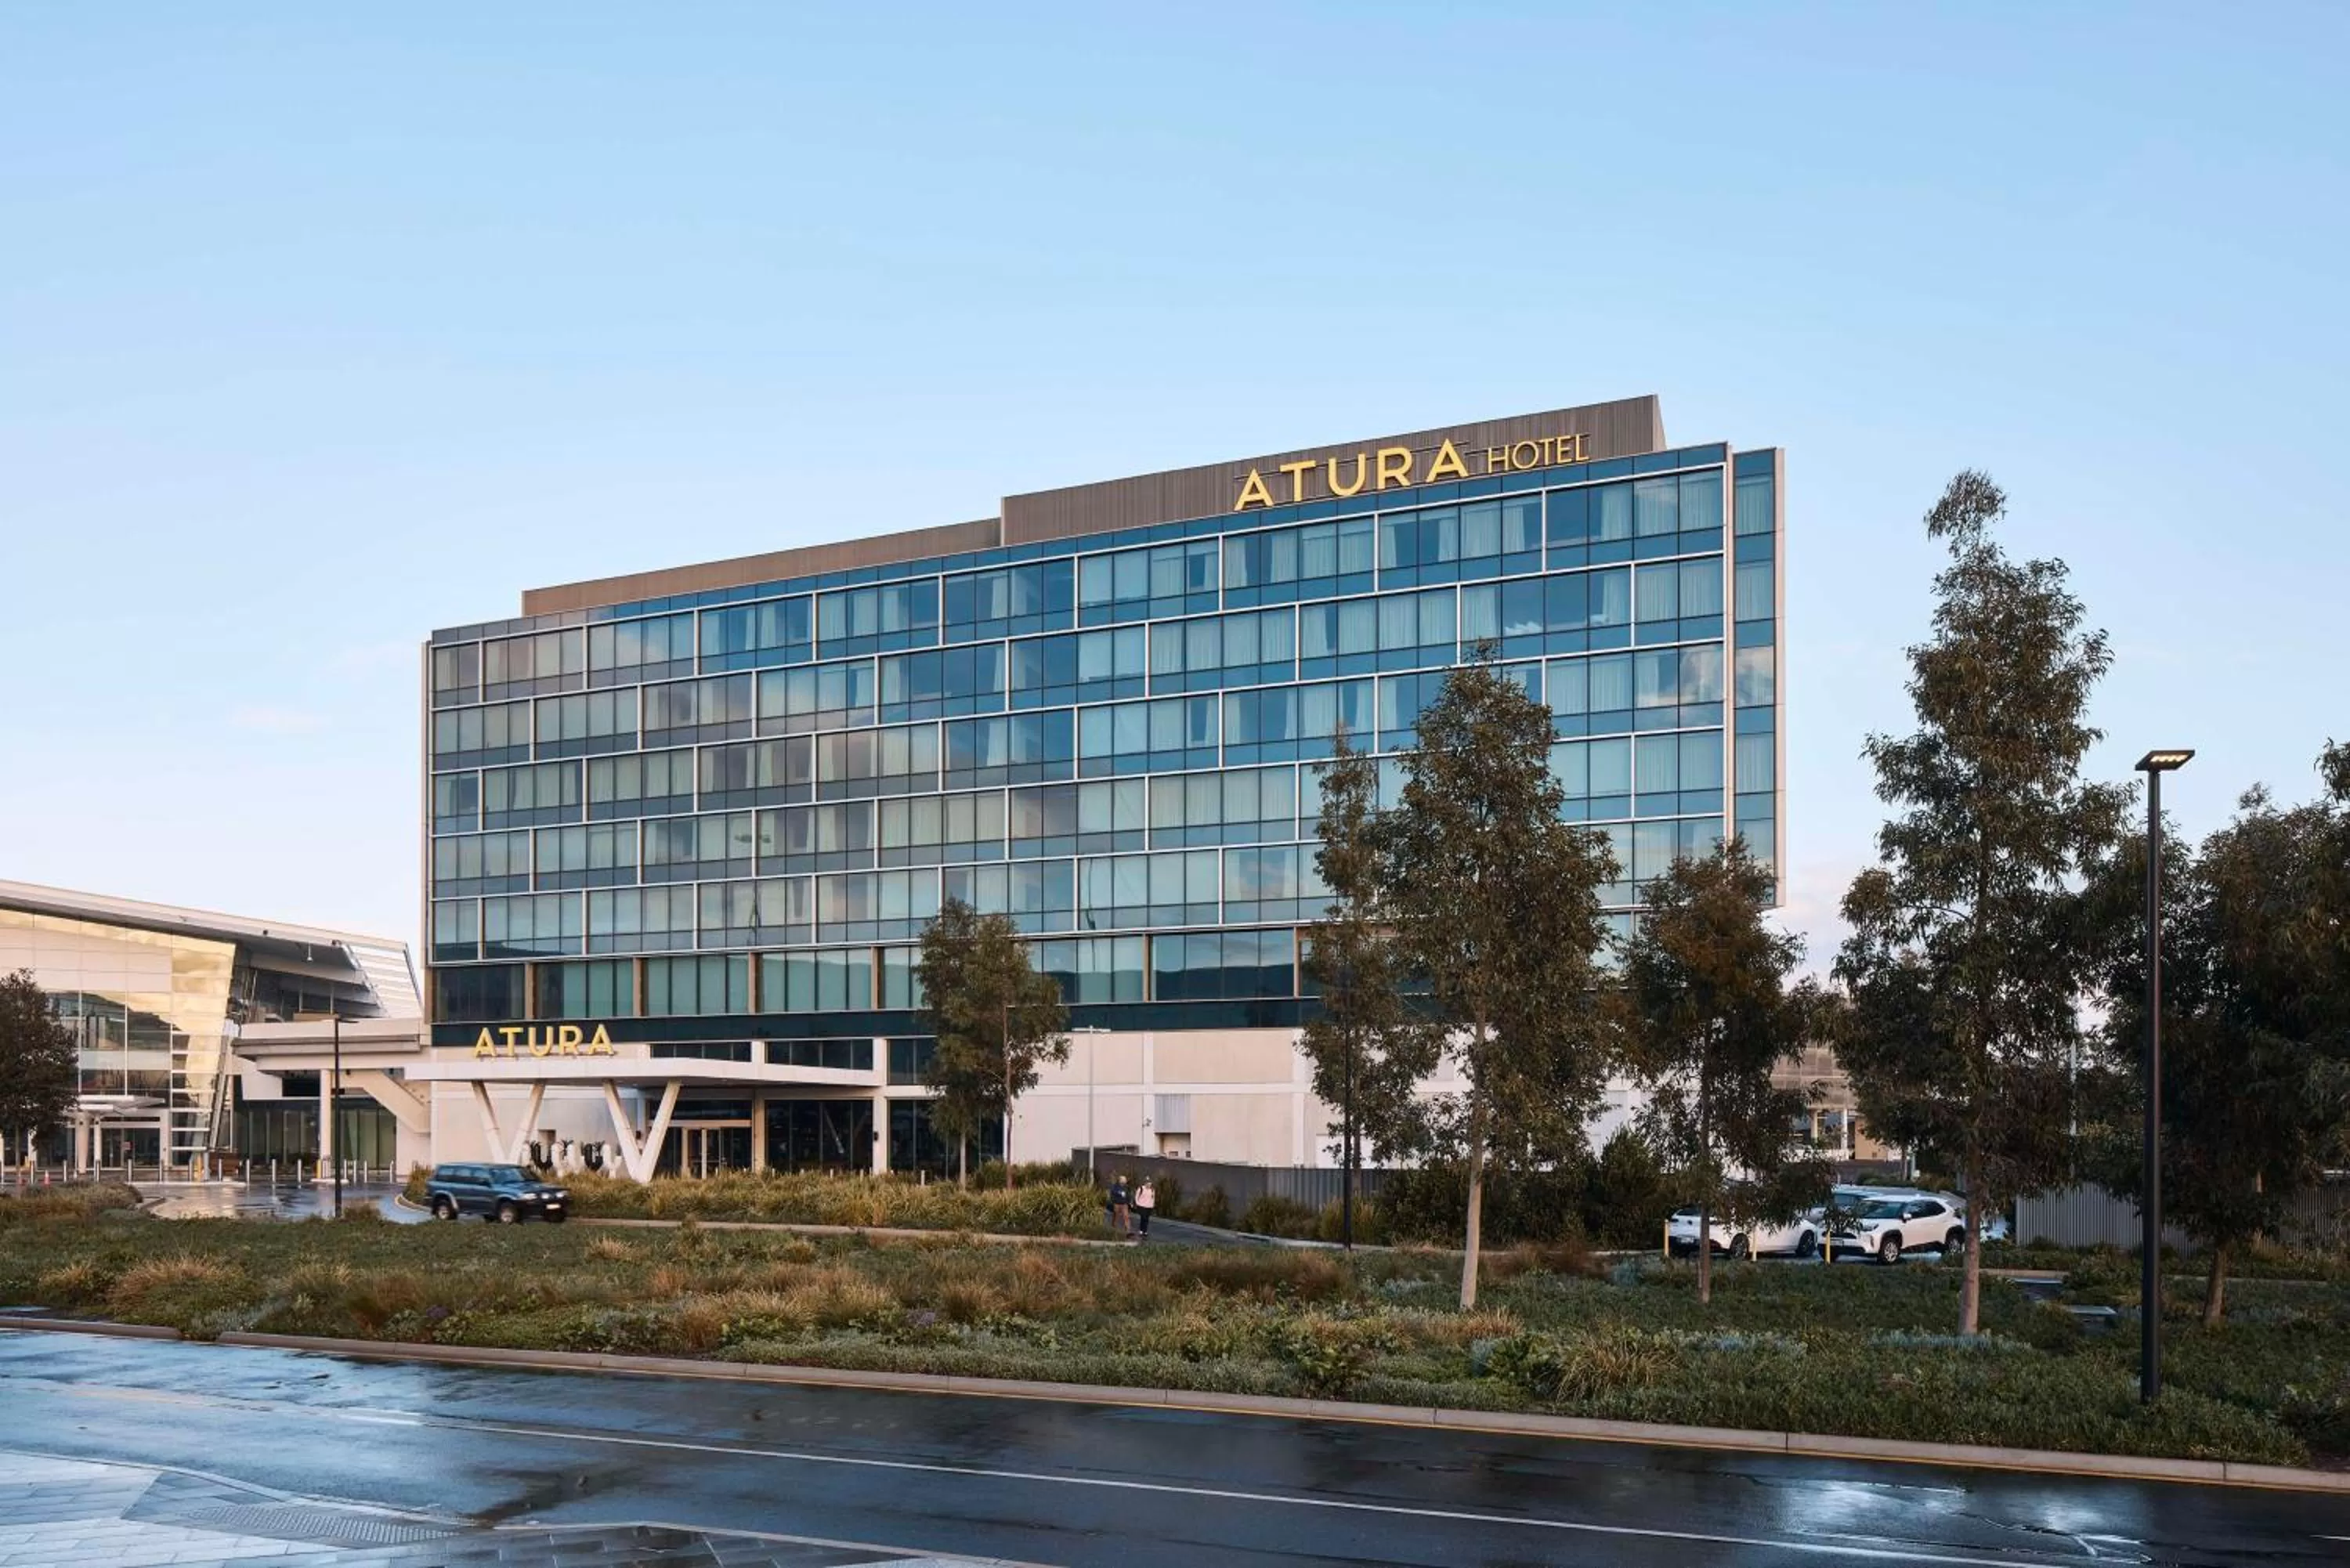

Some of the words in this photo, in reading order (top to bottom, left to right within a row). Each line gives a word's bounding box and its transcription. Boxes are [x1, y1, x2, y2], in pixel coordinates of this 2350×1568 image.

[1234, 438, 1470, 511] ATURA
[1488, 433, 1589, 474] HOTEL
[473, 1024, 614, 1057] ATURA
